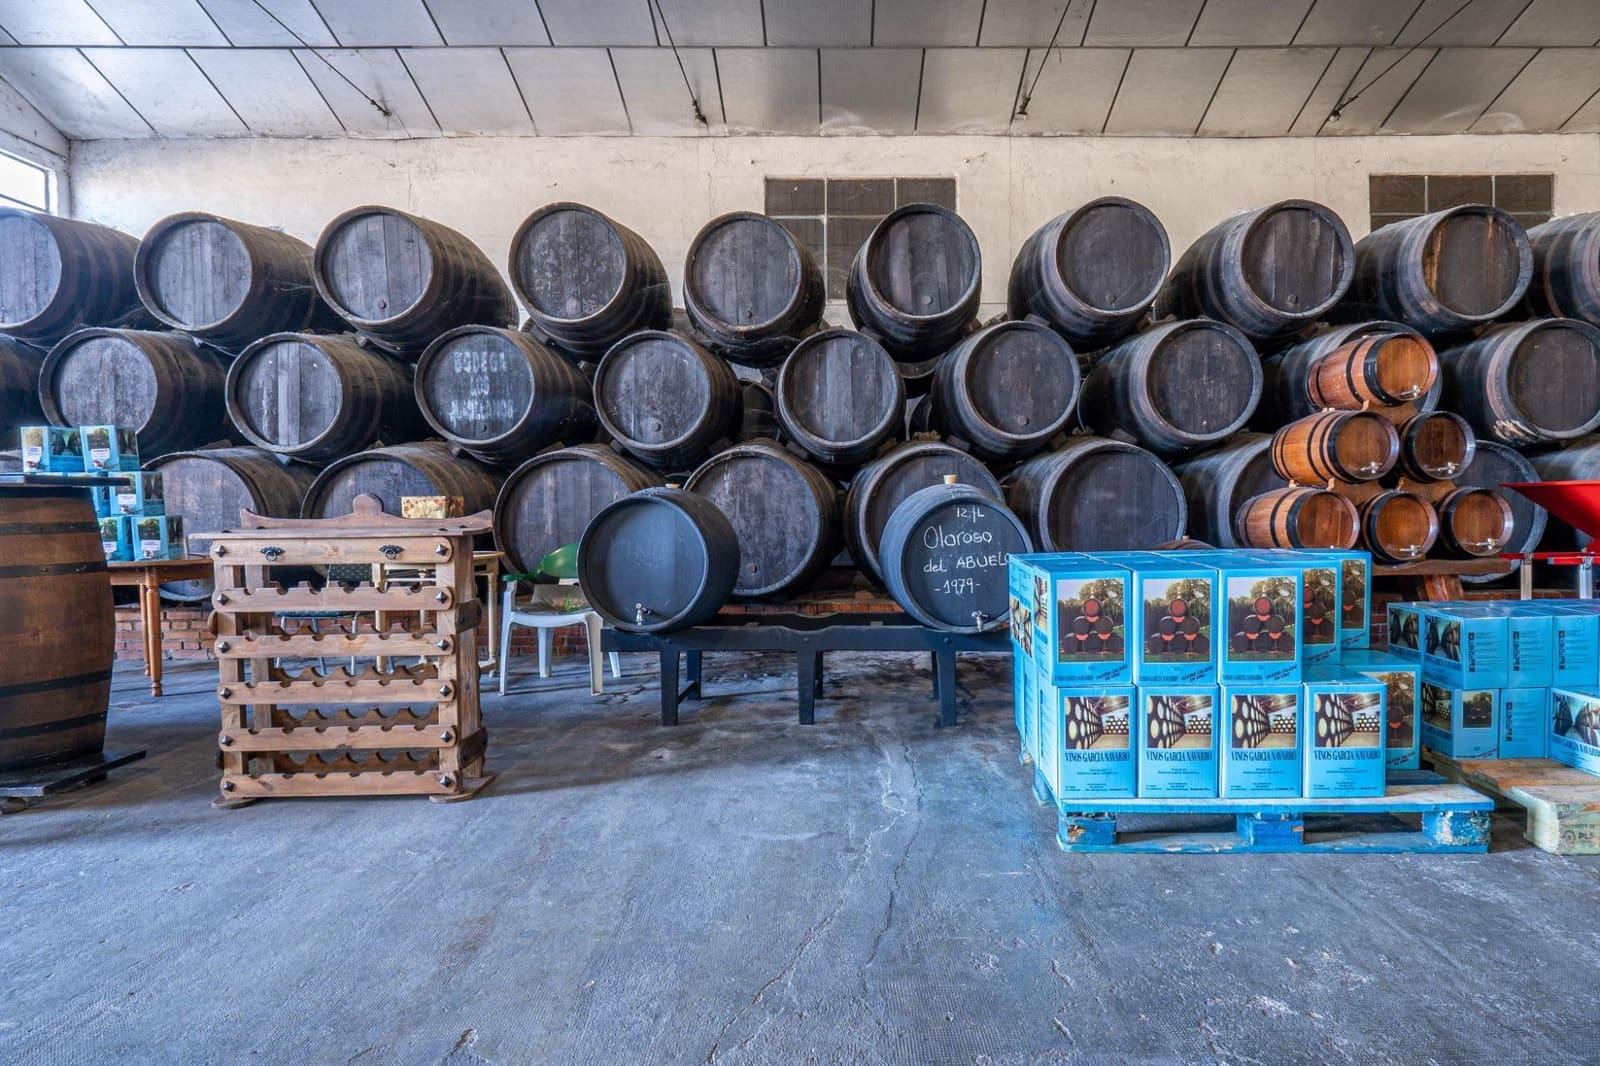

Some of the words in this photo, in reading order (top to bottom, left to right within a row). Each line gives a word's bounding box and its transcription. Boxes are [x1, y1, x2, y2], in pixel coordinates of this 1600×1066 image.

[923, 525, 993, 549] Oloroso
[923, 557, 948, 573] del
[1065, 752, 1082, 761] VINOS
[1146, 751, 1163, 761] VINOS
[1231, 751, 1248, 760] VINOS
[1313, 750, 1331, 760] VINOS
